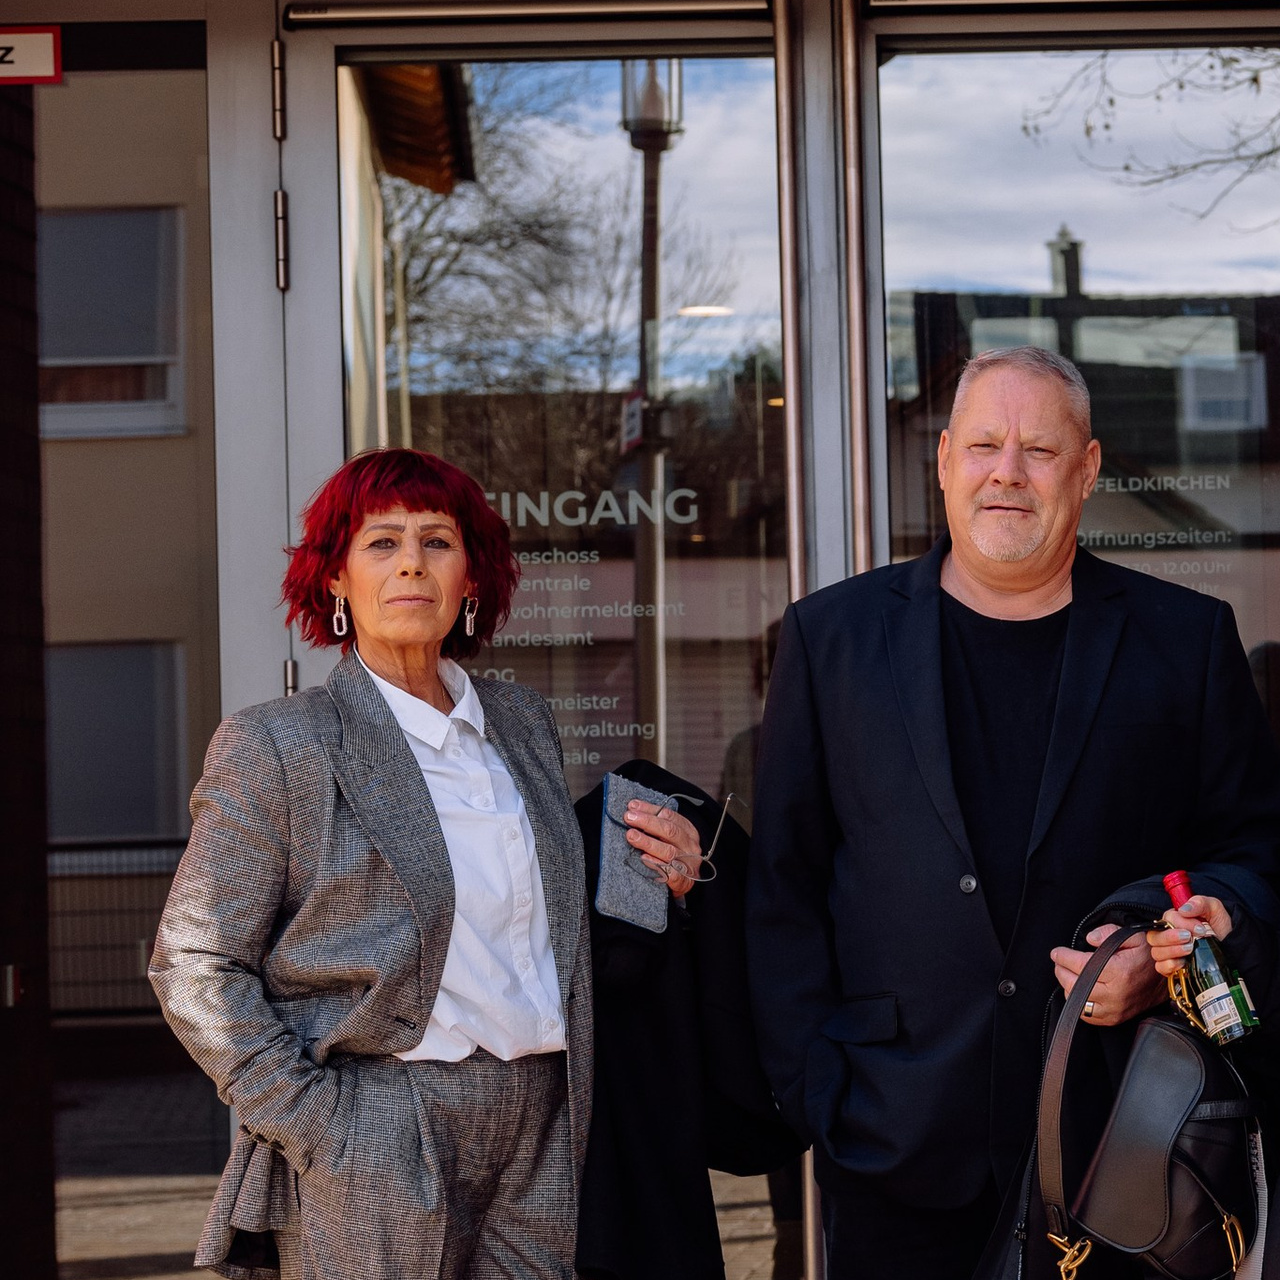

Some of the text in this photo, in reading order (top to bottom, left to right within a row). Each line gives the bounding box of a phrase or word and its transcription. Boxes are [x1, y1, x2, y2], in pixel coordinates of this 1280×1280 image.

[1093, 475, 1230, 493] FELDKIRCHEN
[1203, 560, 1232, 574] Uhr
[518, 574, 591, 591] entrale
[490, 630, 594, 648] andesamt
[547, 693, 620, 710] meister
